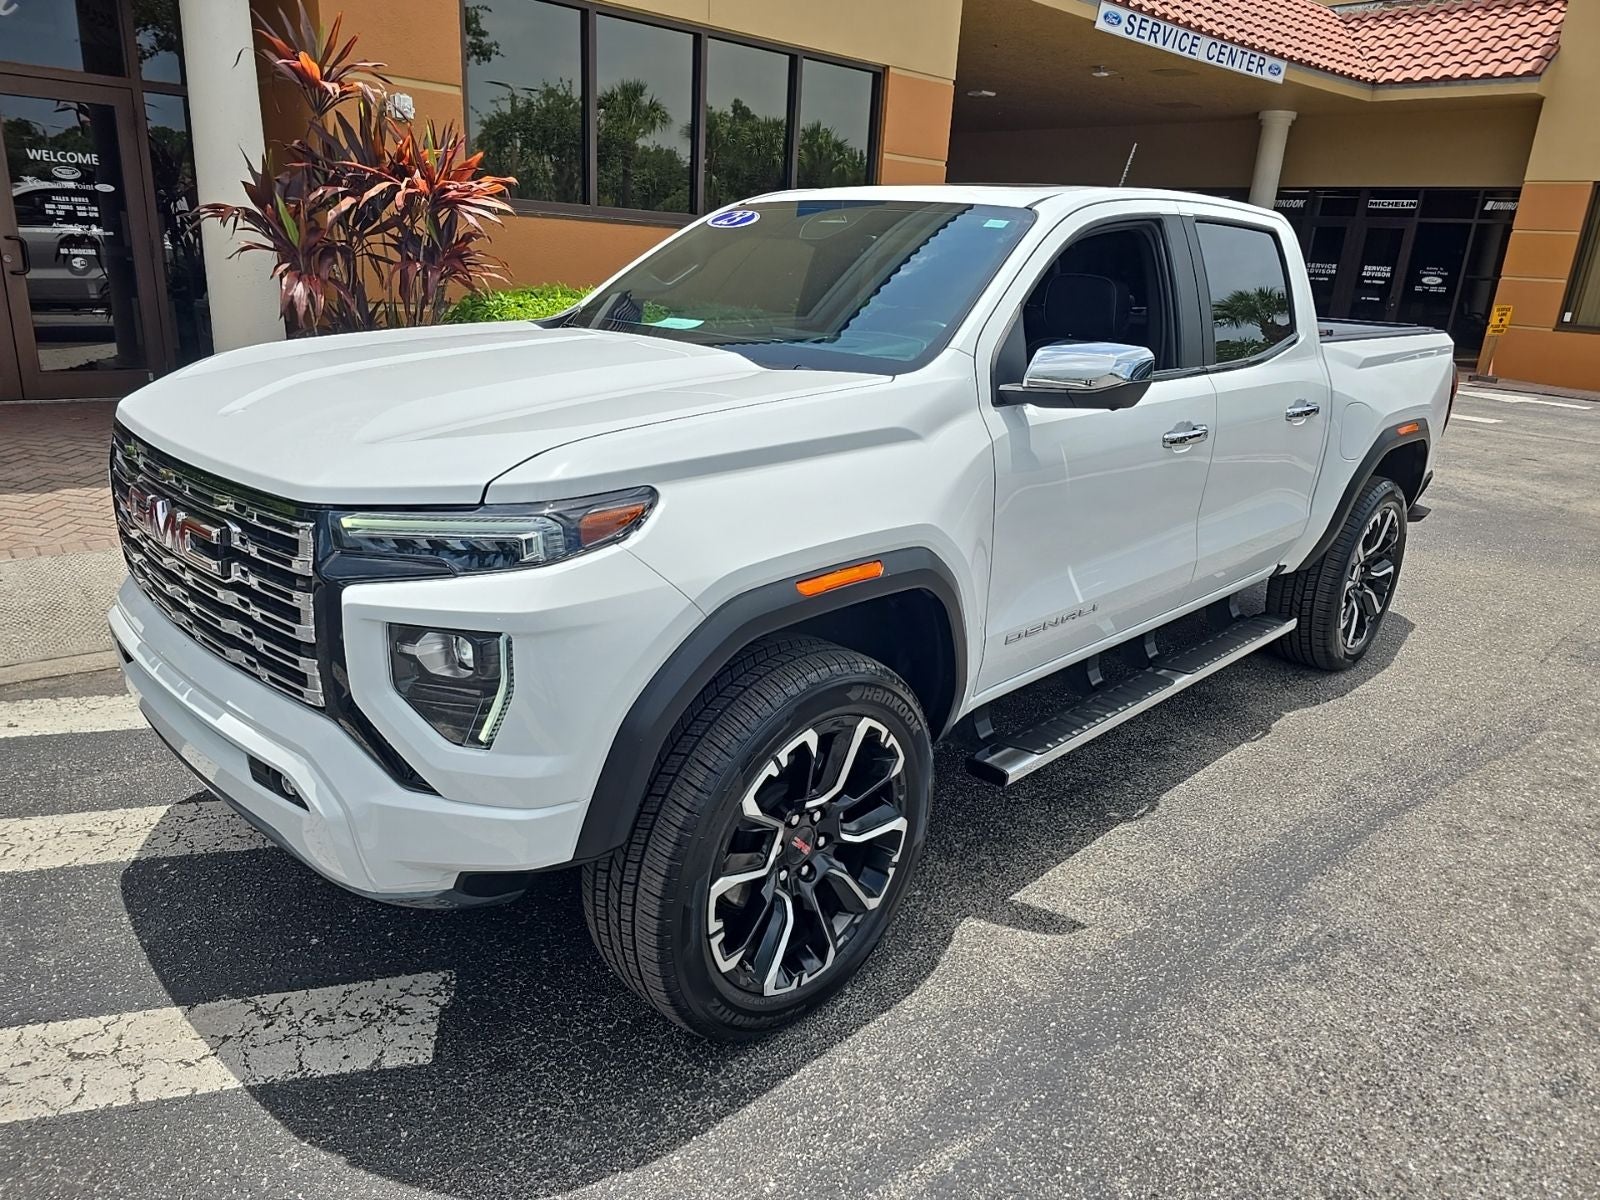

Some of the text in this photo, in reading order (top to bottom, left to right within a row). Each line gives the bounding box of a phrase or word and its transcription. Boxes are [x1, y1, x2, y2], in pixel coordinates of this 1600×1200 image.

[1124, 14, 1200, 56] SERVICE
[1206, 41, 1266, 76] CENTER
[26, 148, 100, 165] WELCOME
[1369, 200, 1417, 208] MICHELIN
[128, 486, 221, 577] GMC
[1004, 603, 1097, 646] DENALI
